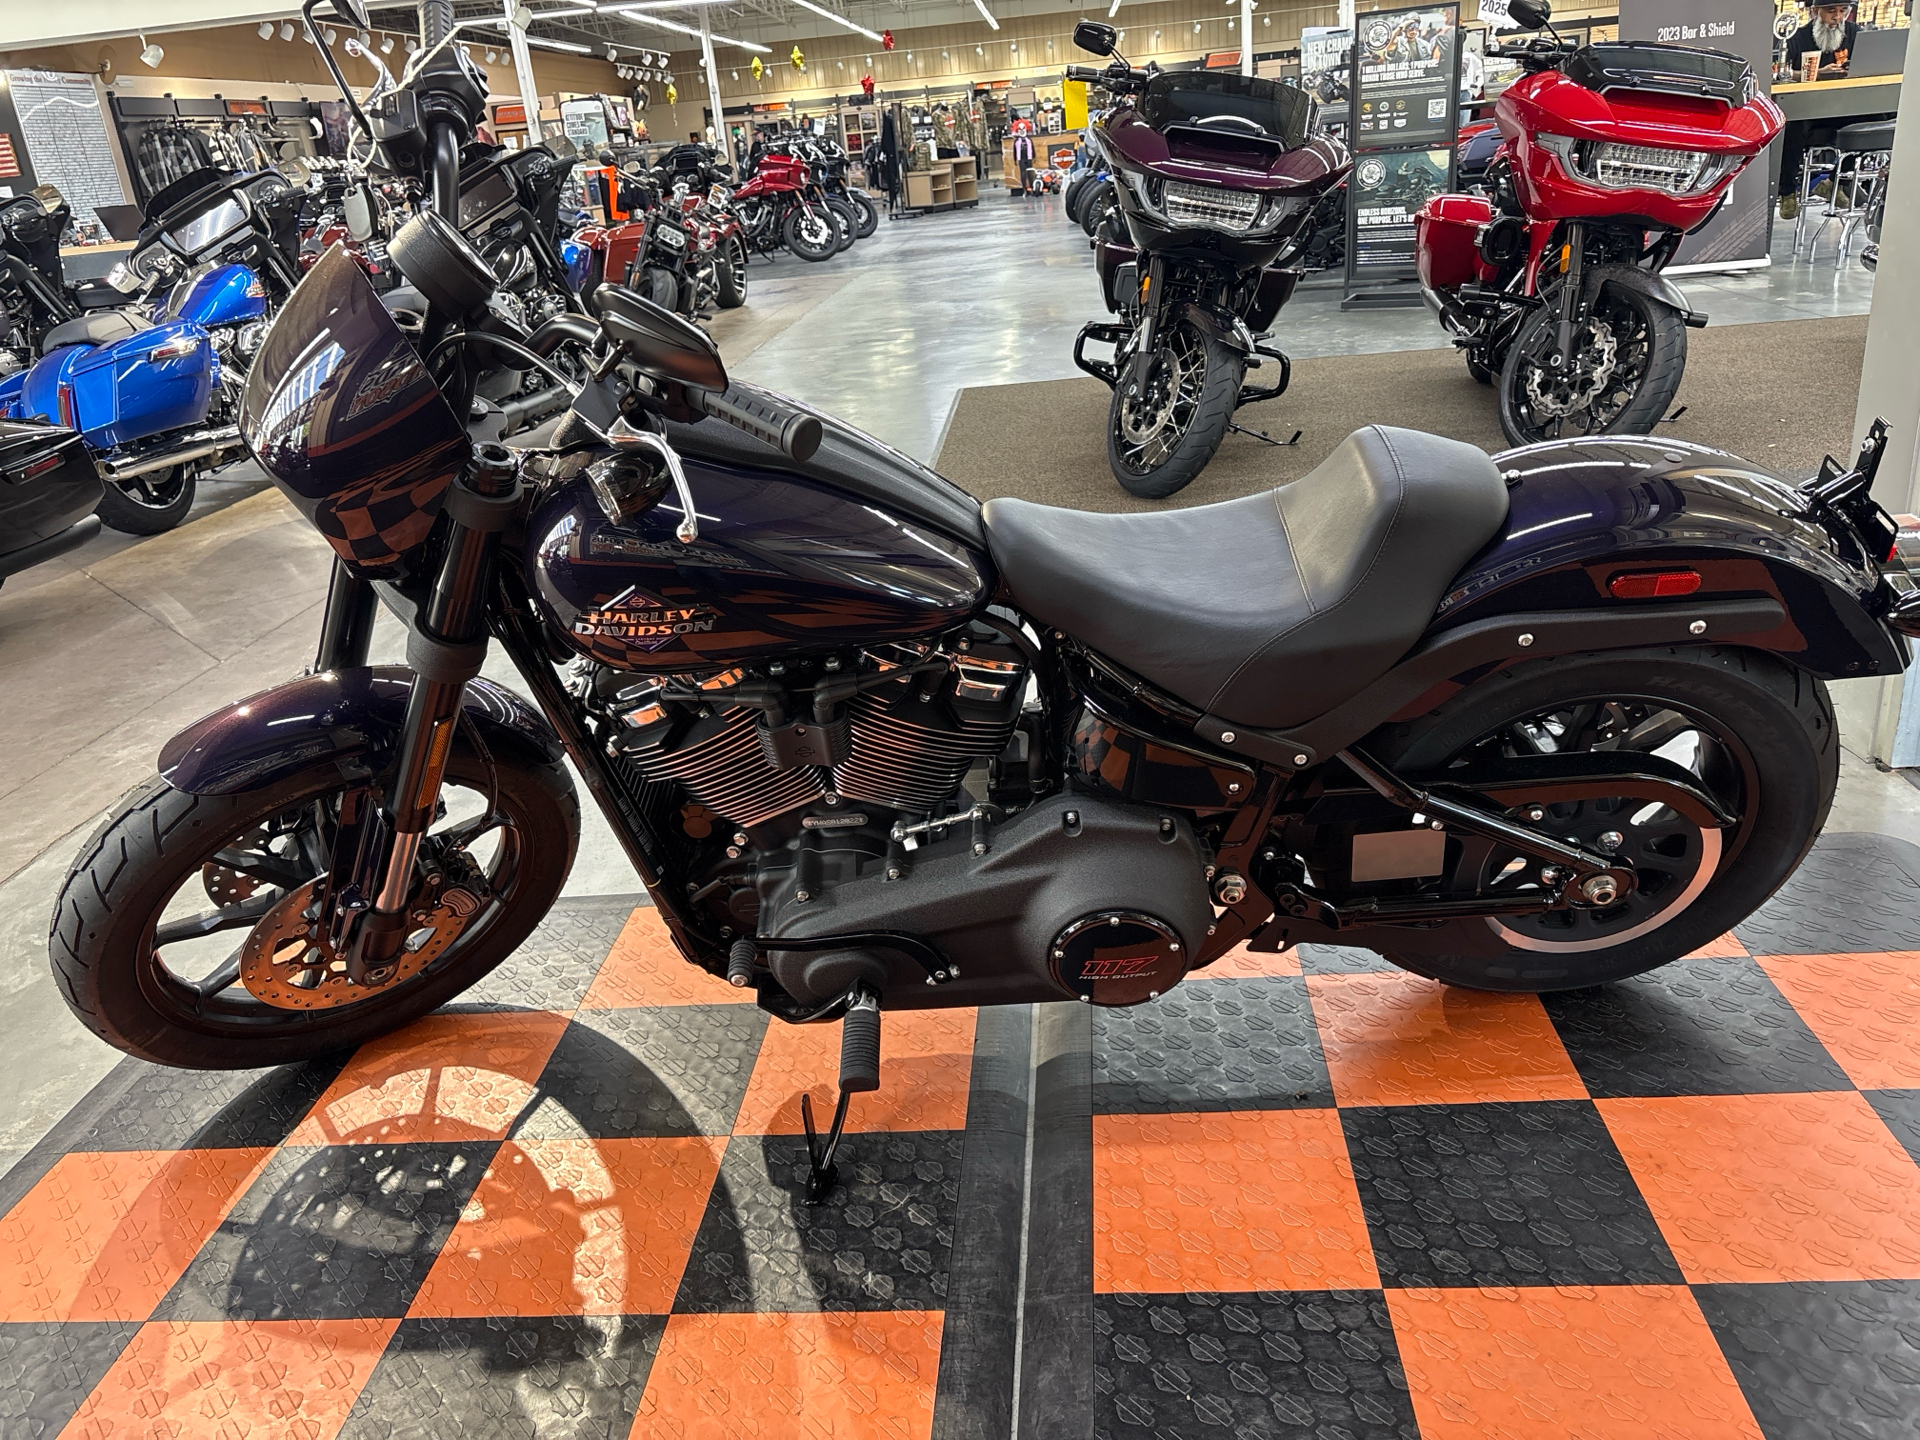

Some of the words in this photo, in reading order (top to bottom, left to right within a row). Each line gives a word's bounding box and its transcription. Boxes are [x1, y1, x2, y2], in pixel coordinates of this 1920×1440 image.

[1482, 0, 1508, 16] 2025
[1657, 26, 1680, 42] 2023
[1682, 25, 1698, 39] Bar
[1700, 23, 1707, 38] &
[1708, 21, 1735, 37] Shield
[1307, 40, 1326, 55] NEW
[1308, 55, 1316, 70] IN
[1317, 52, 1342, 68] TOWN
[10, 74, 34, 84] Growing
[61, 76, 92, 86] Community
[588, 609, 696, 625] HARLEY
[574, 620, 714, 637] DAVIDSON
[1080, 955, 1160, 976] 117
[1111, 970, 1158, 980] OUTPUT
